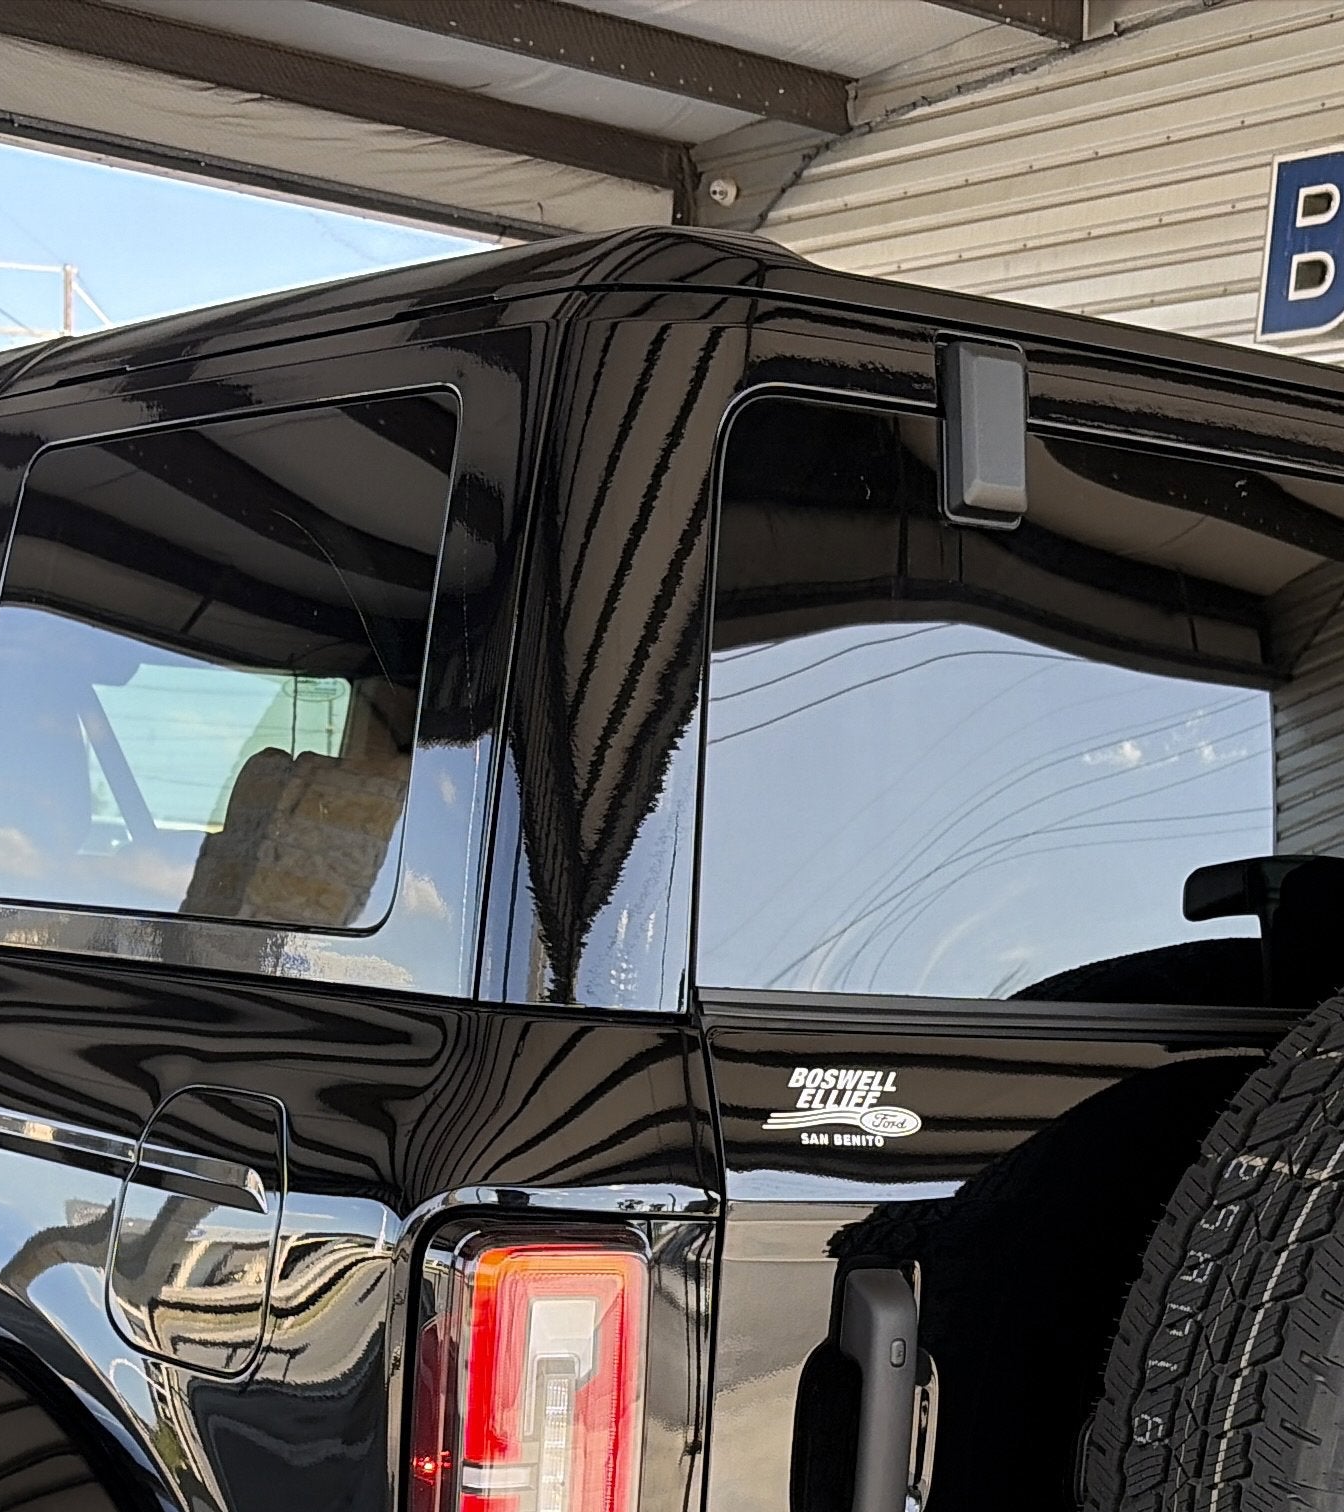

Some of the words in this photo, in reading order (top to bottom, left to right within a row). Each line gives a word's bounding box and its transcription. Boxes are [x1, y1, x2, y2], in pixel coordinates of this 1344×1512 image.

[787, 1067, 897, 1092] BOSWELL
[795, 1088, 882, 1111] ELLIFF
[800, 1132, 829, 1146] SAN
[833, 1133, 885, 1148] BENITO
